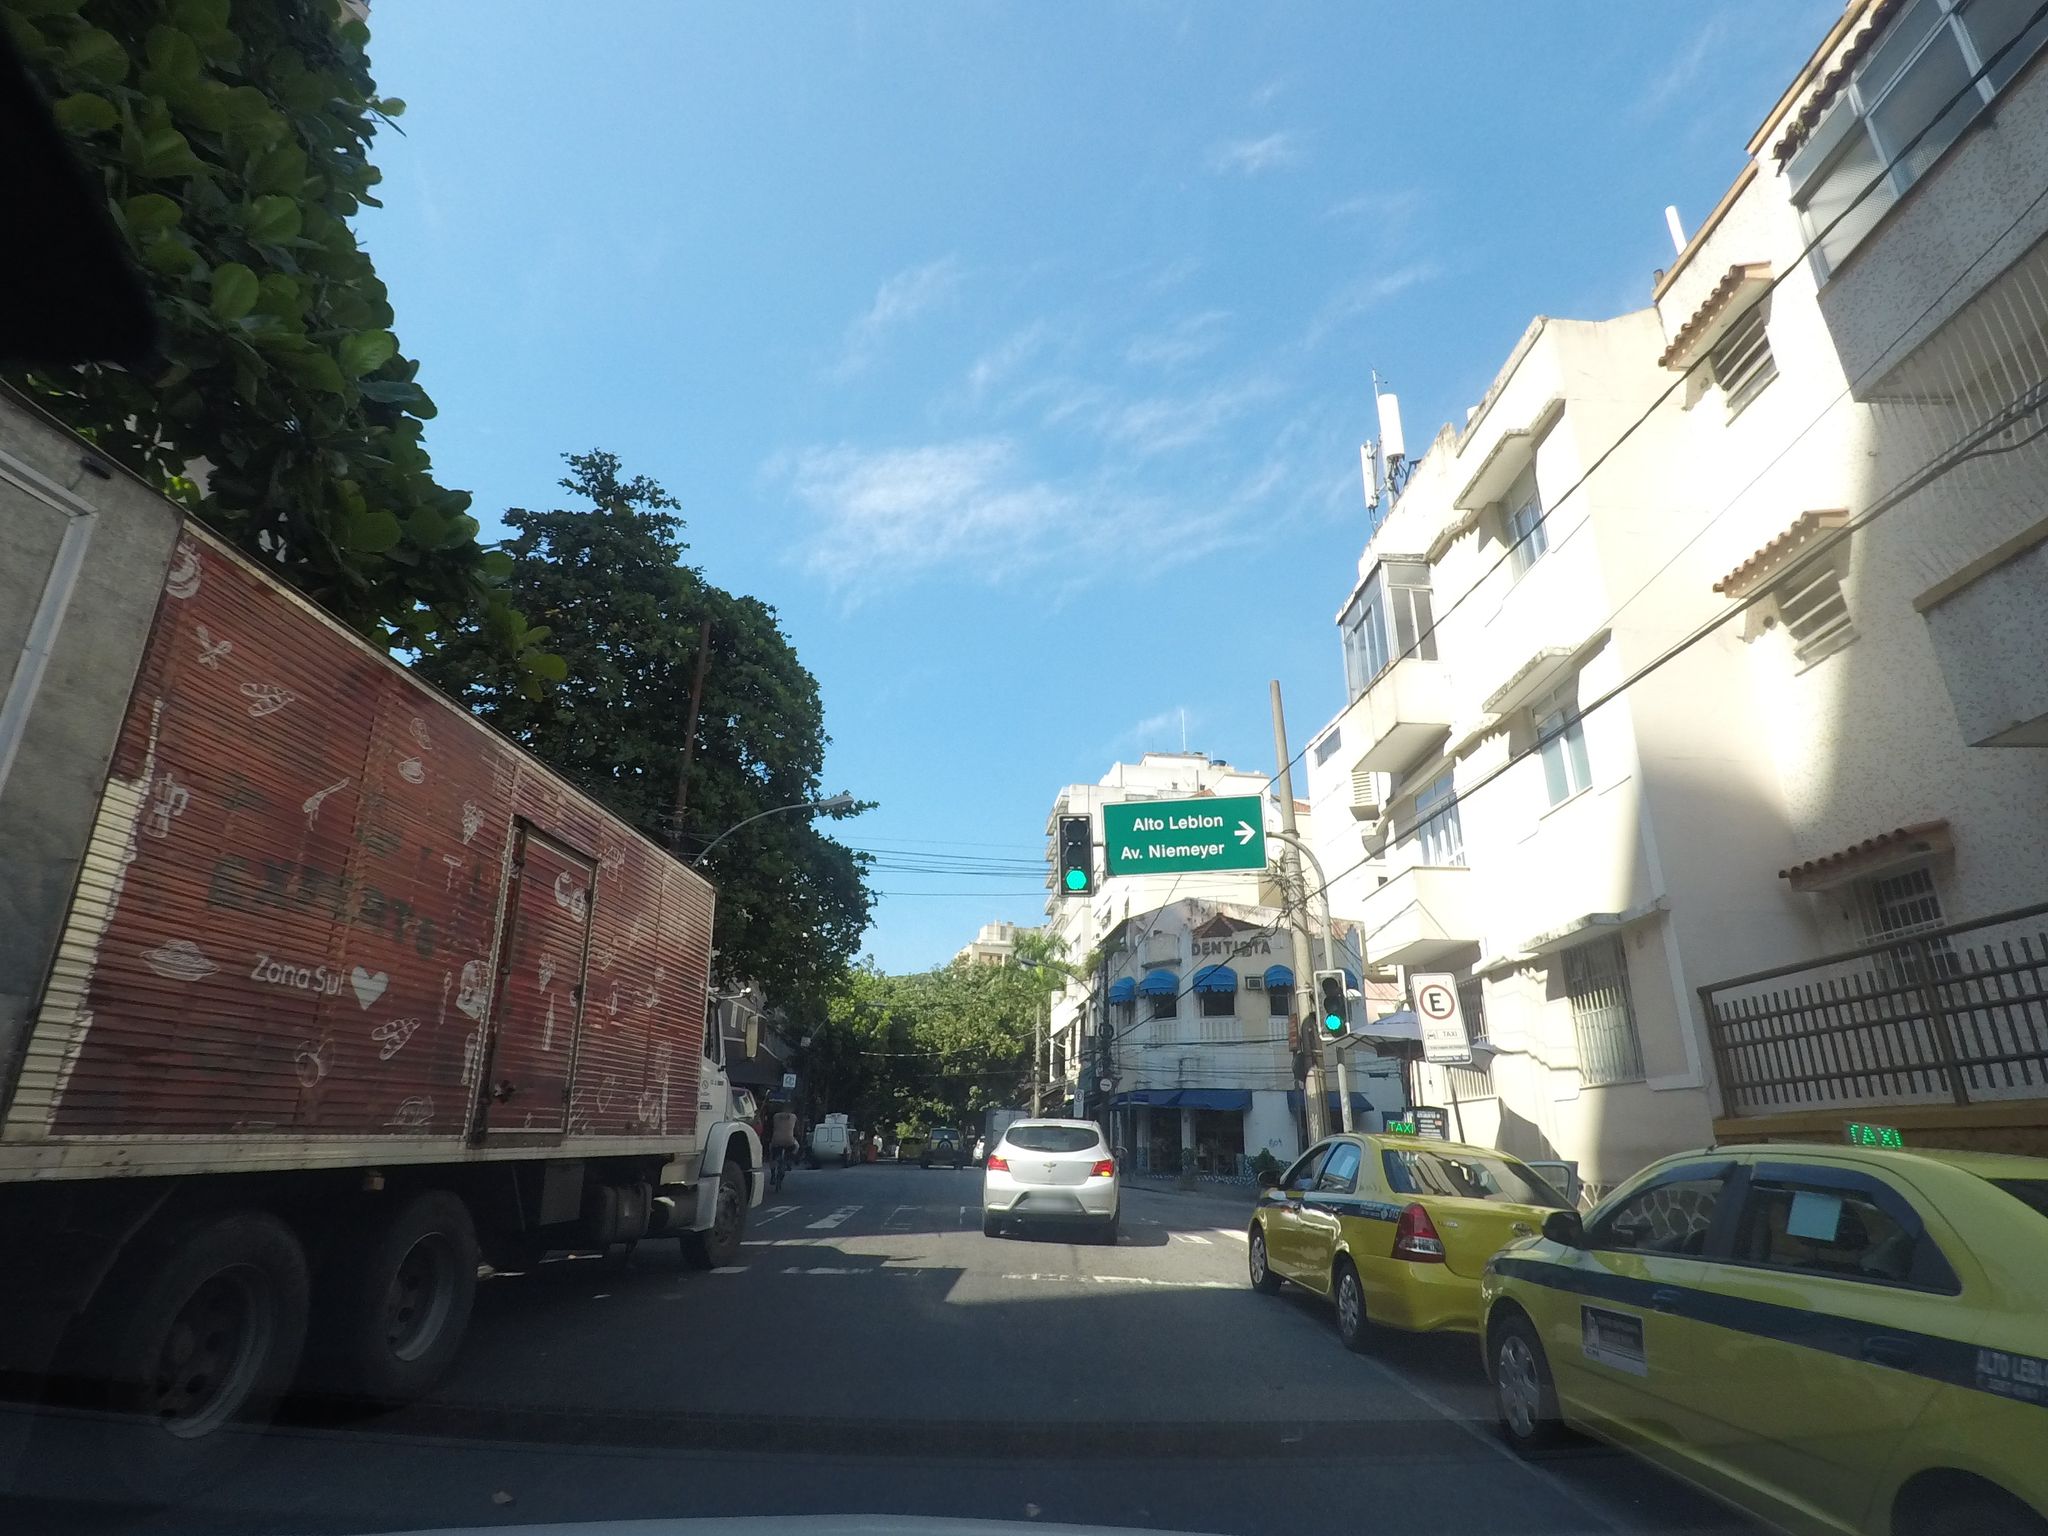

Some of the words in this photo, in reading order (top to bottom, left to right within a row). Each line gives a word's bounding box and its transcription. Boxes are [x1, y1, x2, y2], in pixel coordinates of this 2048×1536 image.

[1132, 817, 1165, 832] Alto
[1169, 814, 1224, 830] Leblon
[1121, 847, 1143, 860] Av.
[1149, 842, 1225, 860] Niemeyer
[251, 951, 311, 989] Zona
[312, 965, 346, 996] Sul
[1428, 993, 1446, 1012] E
[1389, 1121, 1415, 1134] TAXI
[1850, 1124, 1903, 1148] TAXI
